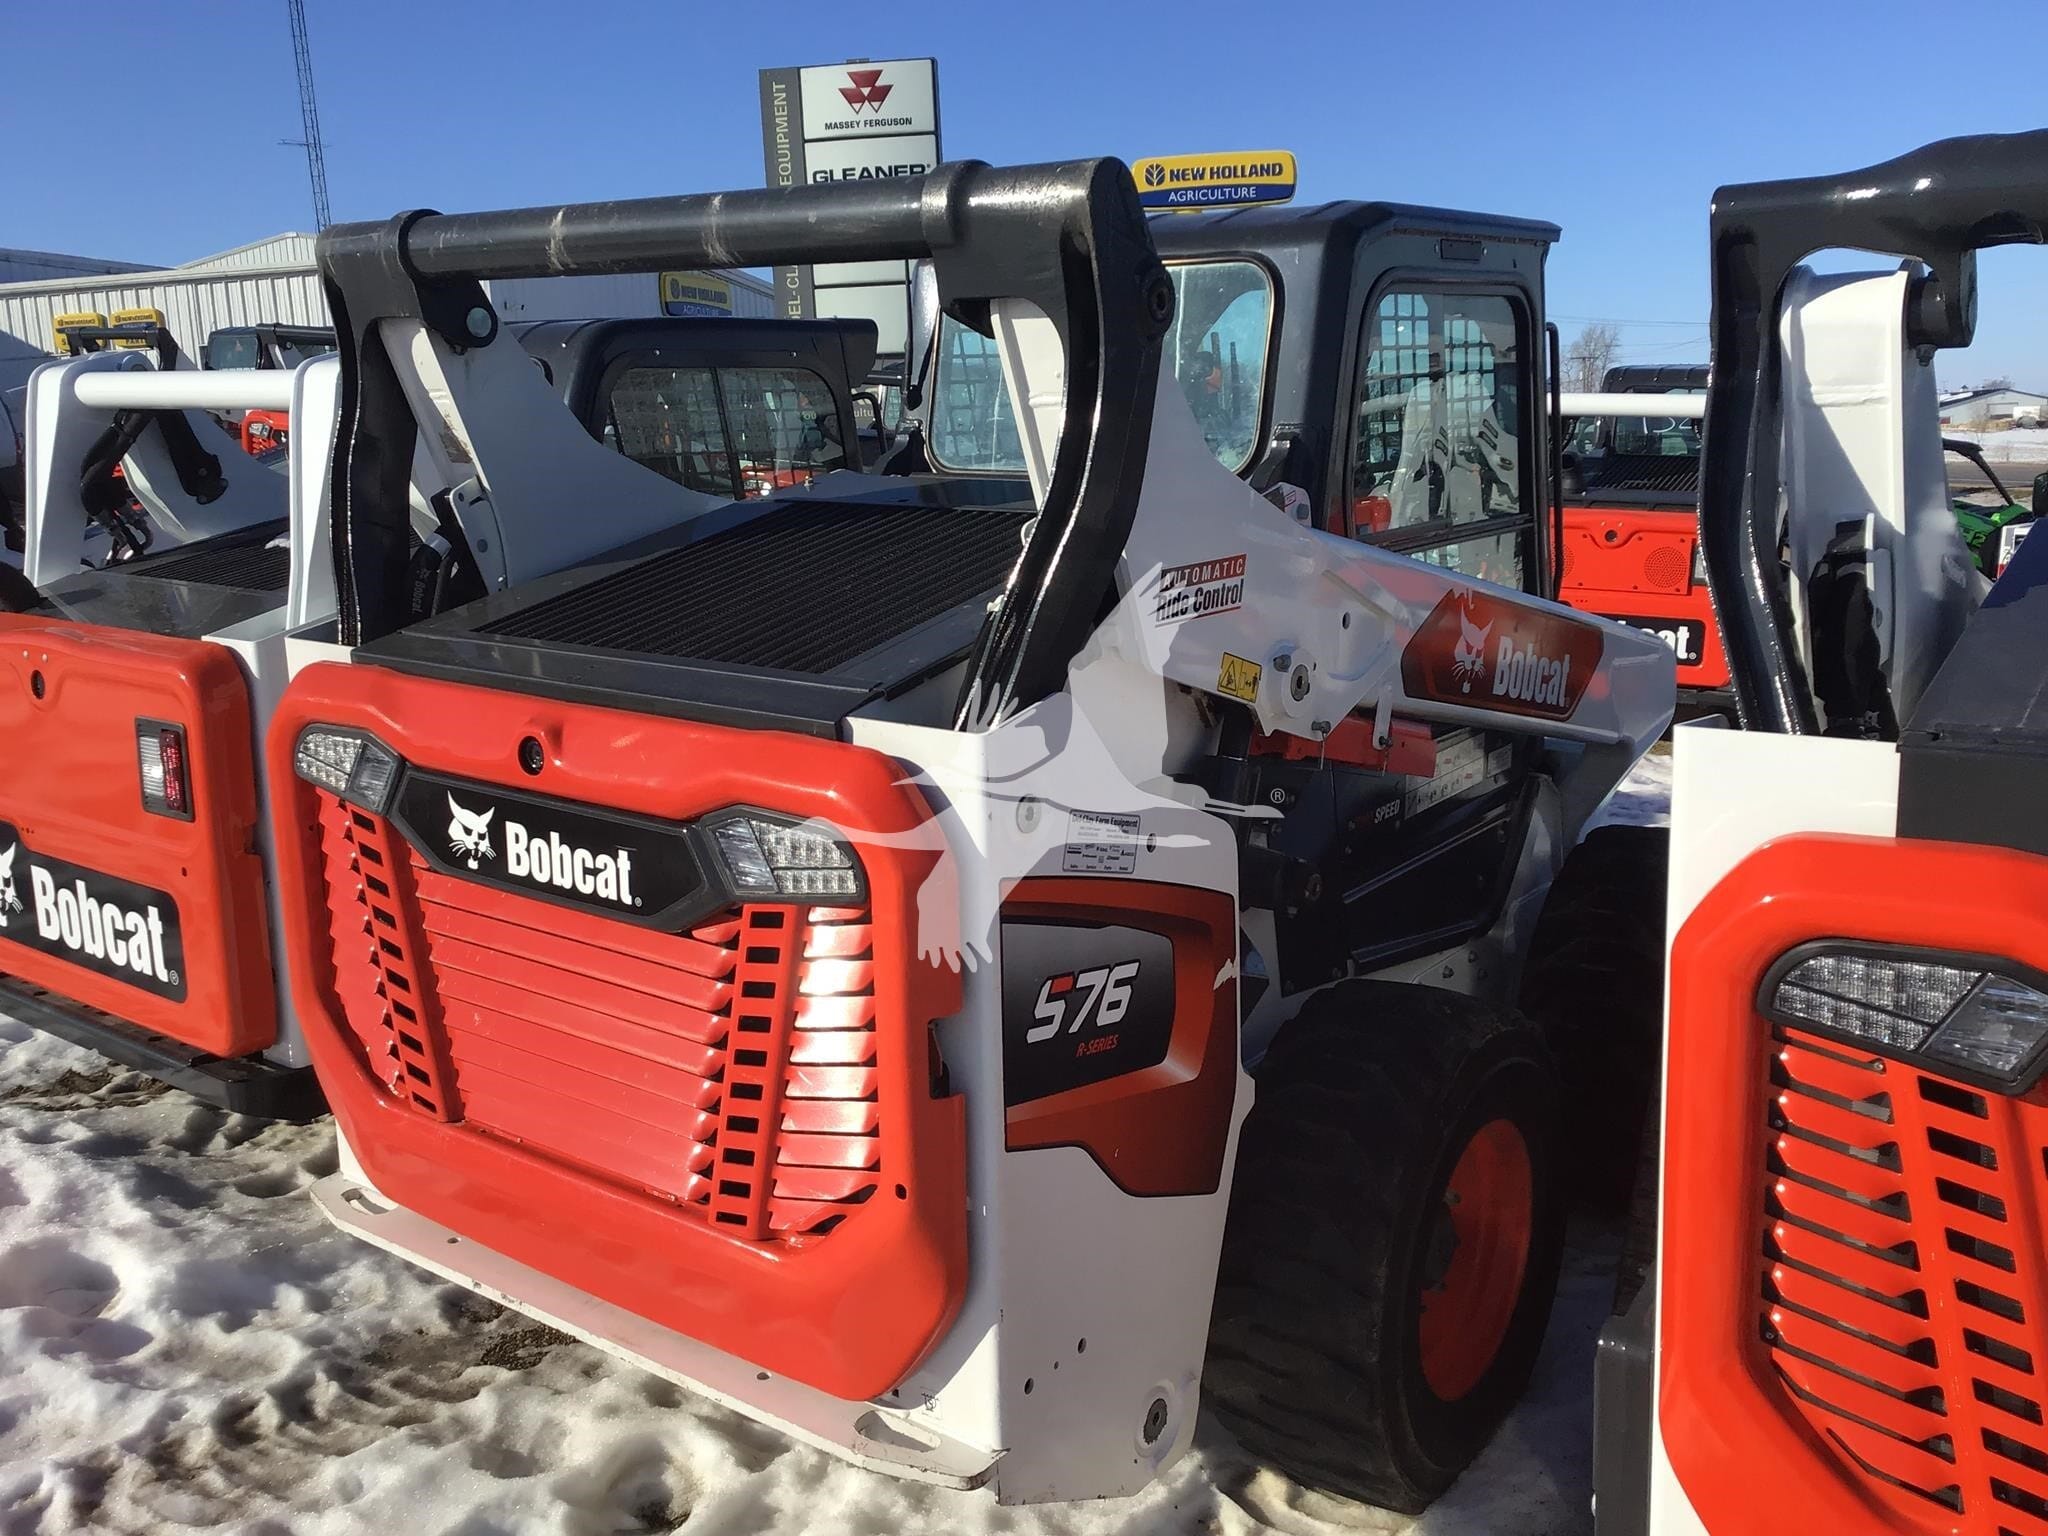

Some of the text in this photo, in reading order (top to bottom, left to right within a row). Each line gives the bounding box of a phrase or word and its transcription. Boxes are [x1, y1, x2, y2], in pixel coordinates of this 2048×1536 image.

[772, 81, 793, 186] EQUIPMENT
[824, 117, 913, 131] MASSEY FERGUSON
[1169, 162, 1284, 183] NEW HOLLAND
[1168, 186, 1257, 203] AGRICULTURE
[1163, 558, 1244, 590] AUTOMATIC
[1156, 578, 1245, 622] Ride Control
[1492, 635, 1571, 707] Bobcat
[1374, 799, 1401, 824] SPEED
[505, 821, 633, 905] Bobcat
[30, 865, 169, 983] Bobcat
[1026, 960, 1140, 1044] S76
[1076, 1034, 1120, 1057] R-SERIES
